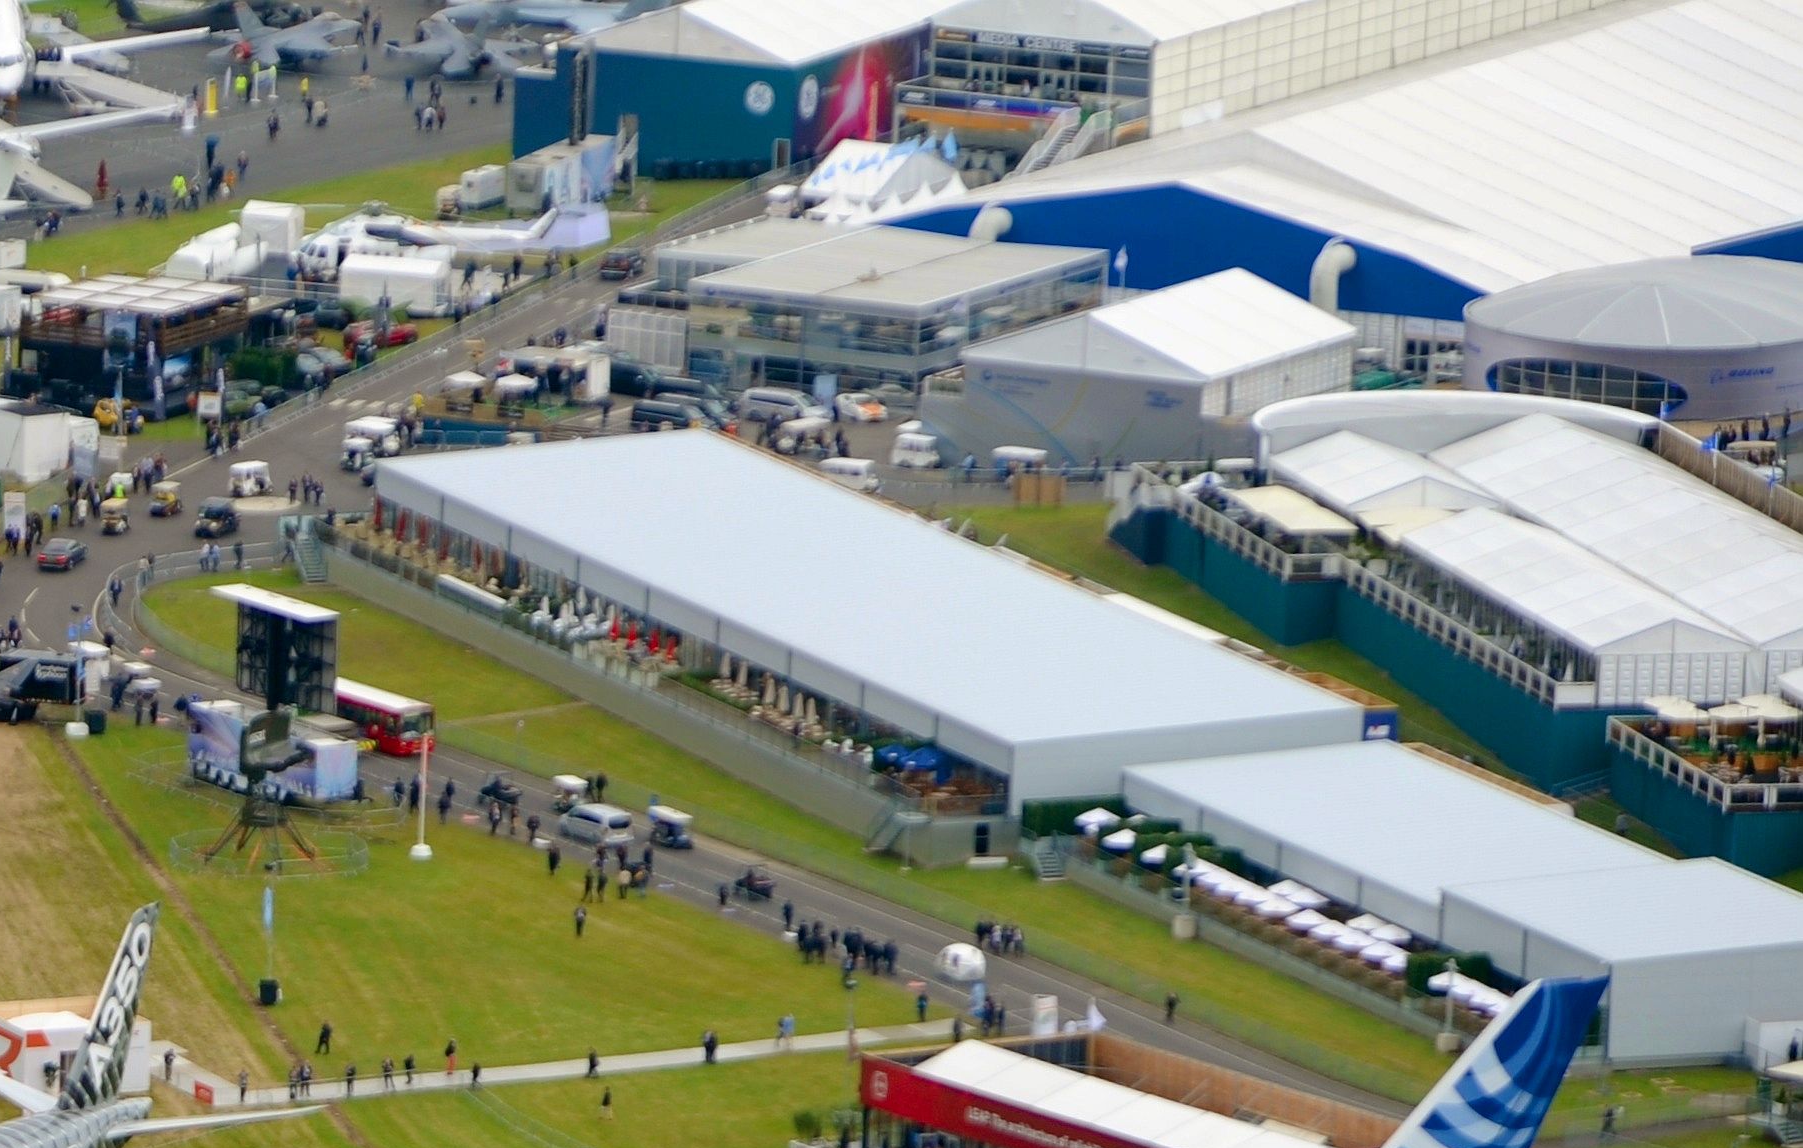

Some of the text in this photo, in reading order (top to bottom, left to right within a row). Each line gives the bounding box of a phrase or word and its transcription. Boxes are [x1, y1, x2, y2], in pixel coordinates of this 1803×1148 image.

[976, 31, 1020, 46] MEDIA
[1024, 36, 1078, 51] CENTRE
[89, 922, 152, 1089] A350
